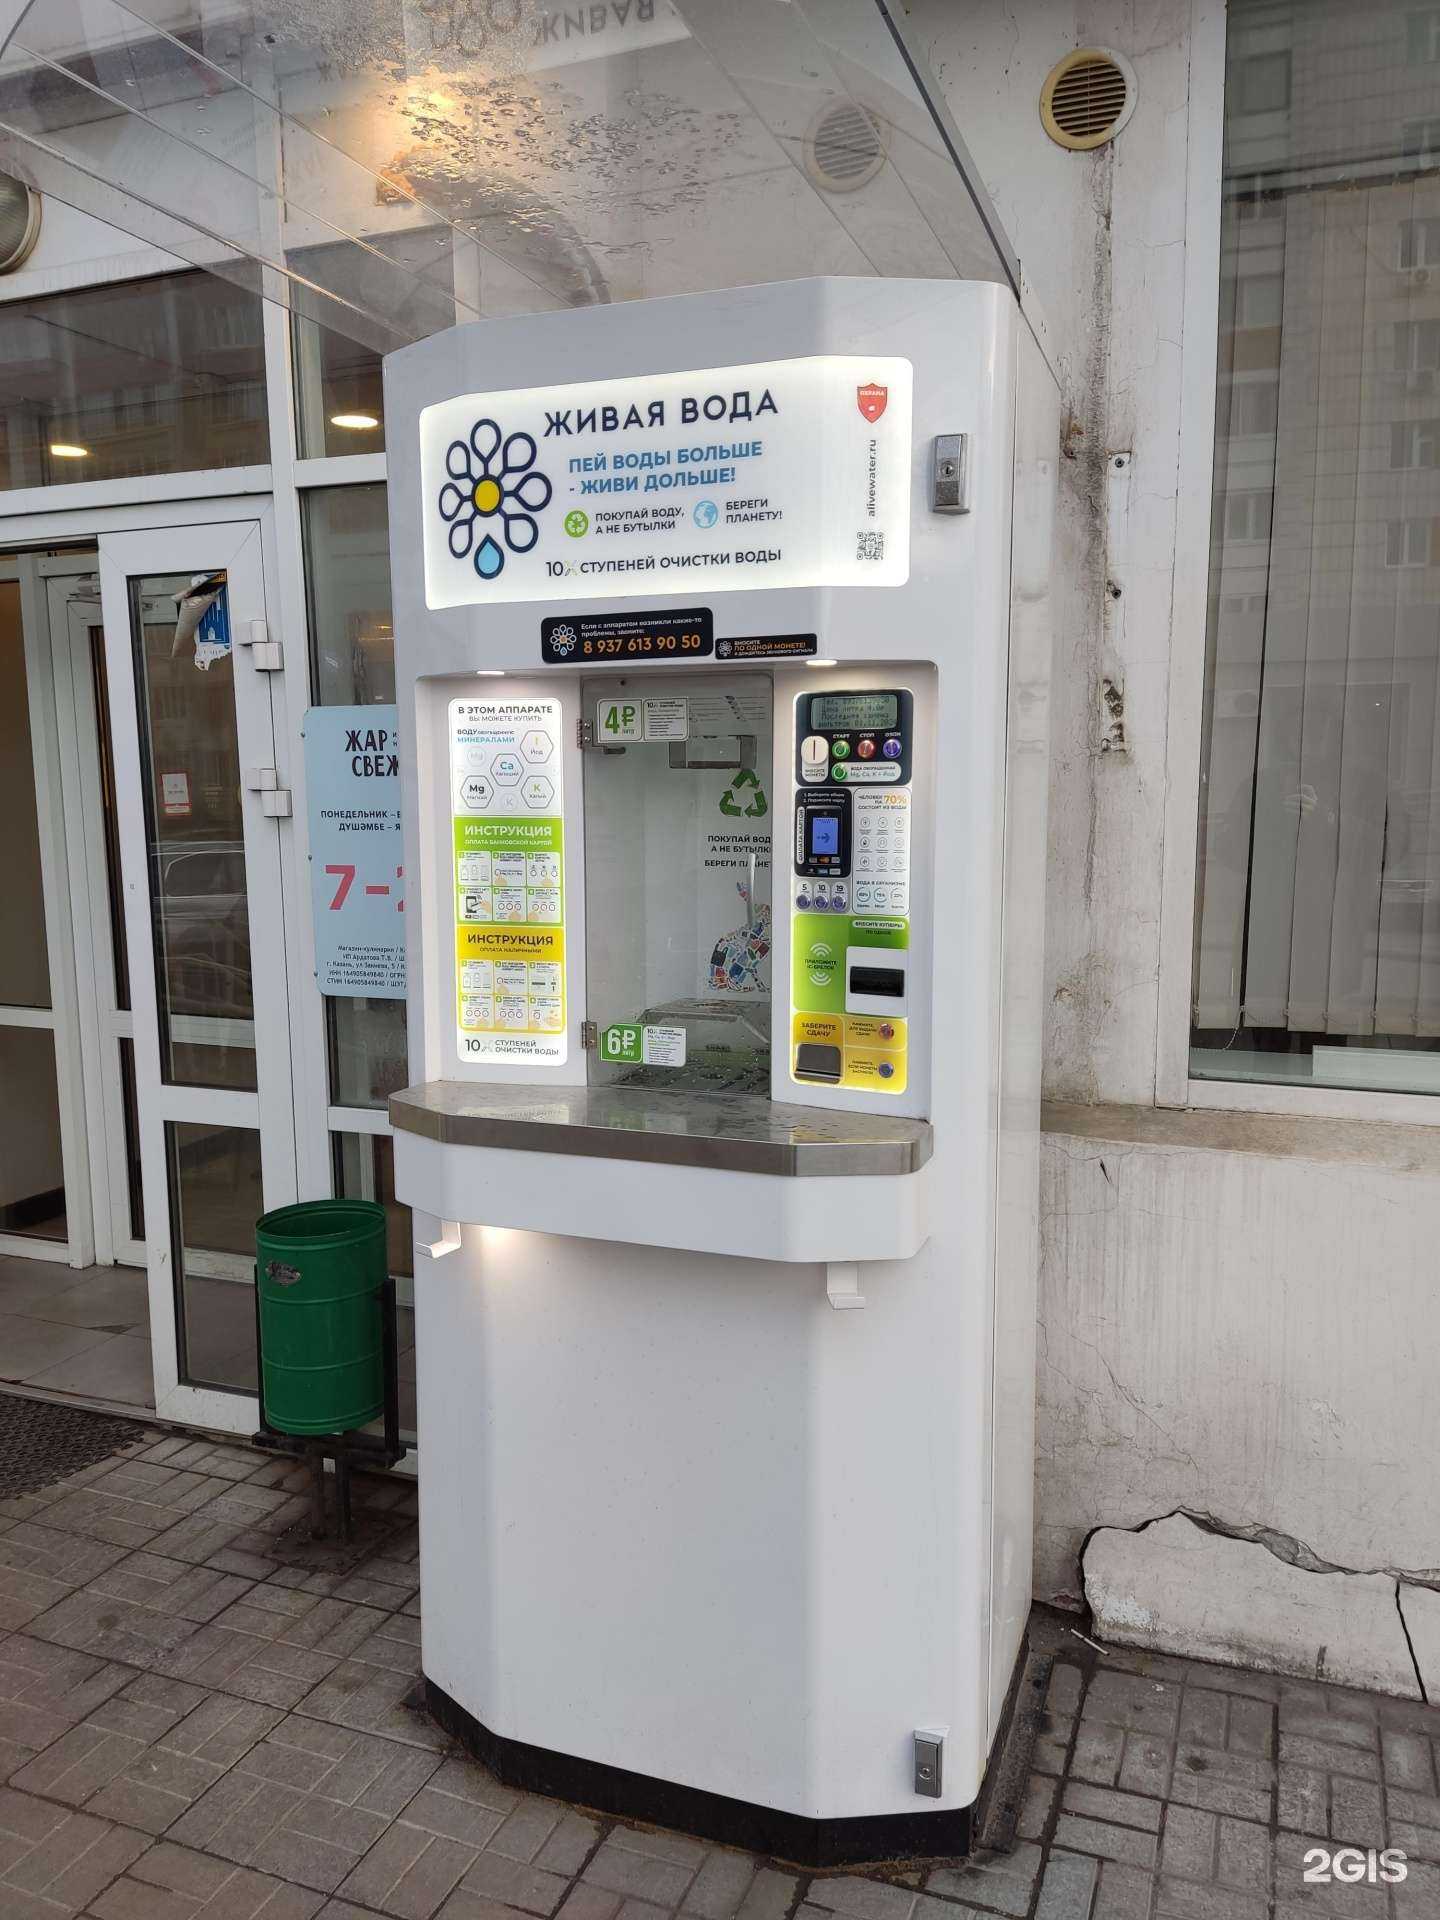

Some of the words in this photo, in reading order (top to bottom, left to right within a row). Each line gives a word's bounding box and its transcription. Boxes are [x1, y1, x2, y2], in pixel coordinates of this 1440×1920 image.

[544, 400, 664, 437] ЖИВАЯ
[681, 389, 778, 424] ВОДА
[569, 453, 606, 473] ПЕЙ
[613, 450, 671, 470] ВОДЫ
[677, 441, 762, 463] БОЛЬШЕ
[581, 476, 638, 494] ЖИВИ
[644, 467, 736, 491] ДОЛЬШЕ!
[867, 439, 877, 517] alivewater.ru
[726, 499, 768, 511] БЕРЕГИ
[596, 507, 648, 521] ПОКУПАЙ
[651, 506, 684, 519] ВОДУ,
[726, 511, 782, 524] ПЛАНЕТУ!
[595, 525, 603, 534] А
[606, 524, 620, 534] НЕ
[624, 521, 676, 533] БУТЫЛКИ
[546, 561, 563, 577] 10
[580, 556, 655, 574] СТУПЕНЕЙ
[660, 552, 730, 569] ОЧИСТКИ
[735, 548, 781, 564] ВОДЫ
[583, 641, 593, 654] 8
[597, 639, 622, 653] 937
[628, 638, 651, 651] 613
[657, 636, 676, 650] 90
[681, 634, 701, 648] 50
[746, 643, 773, 651] ОДНОЙ
[467, 706, 495, 714] ЭТОМ
[498, 705, 553, 714] АППАРАТЕ
[345, 730, 388, 752] ЖАР
[500, 761, 514, 770] Ca
[469, 785, 485, 794] Mg
[320, 810, 388, 819] ПОНЕДЕЛЬНИК
[464, 824, 553, 837] ИНСТРУКЦИЯ
[707, 834, 750, 843] ПОКУПАЙ
[704, 859, 737, 868] БЕРЕГИ
[467, 934, 554, 946] ИНСТРУКЦИЯ
[802, 1022, 837, 1031] ЗАБЕРИТЕ
[806, 1029, 831, 1038] СДАЧУ
[465, 1038, 481, 1052] 10
[495, 1039, 537, 1047] СТУПЕНЕЙ
[495, 1047, 533, 1055] ОЧИСТКИ
[534, 1047, 559, 1056] ВОДЫ
